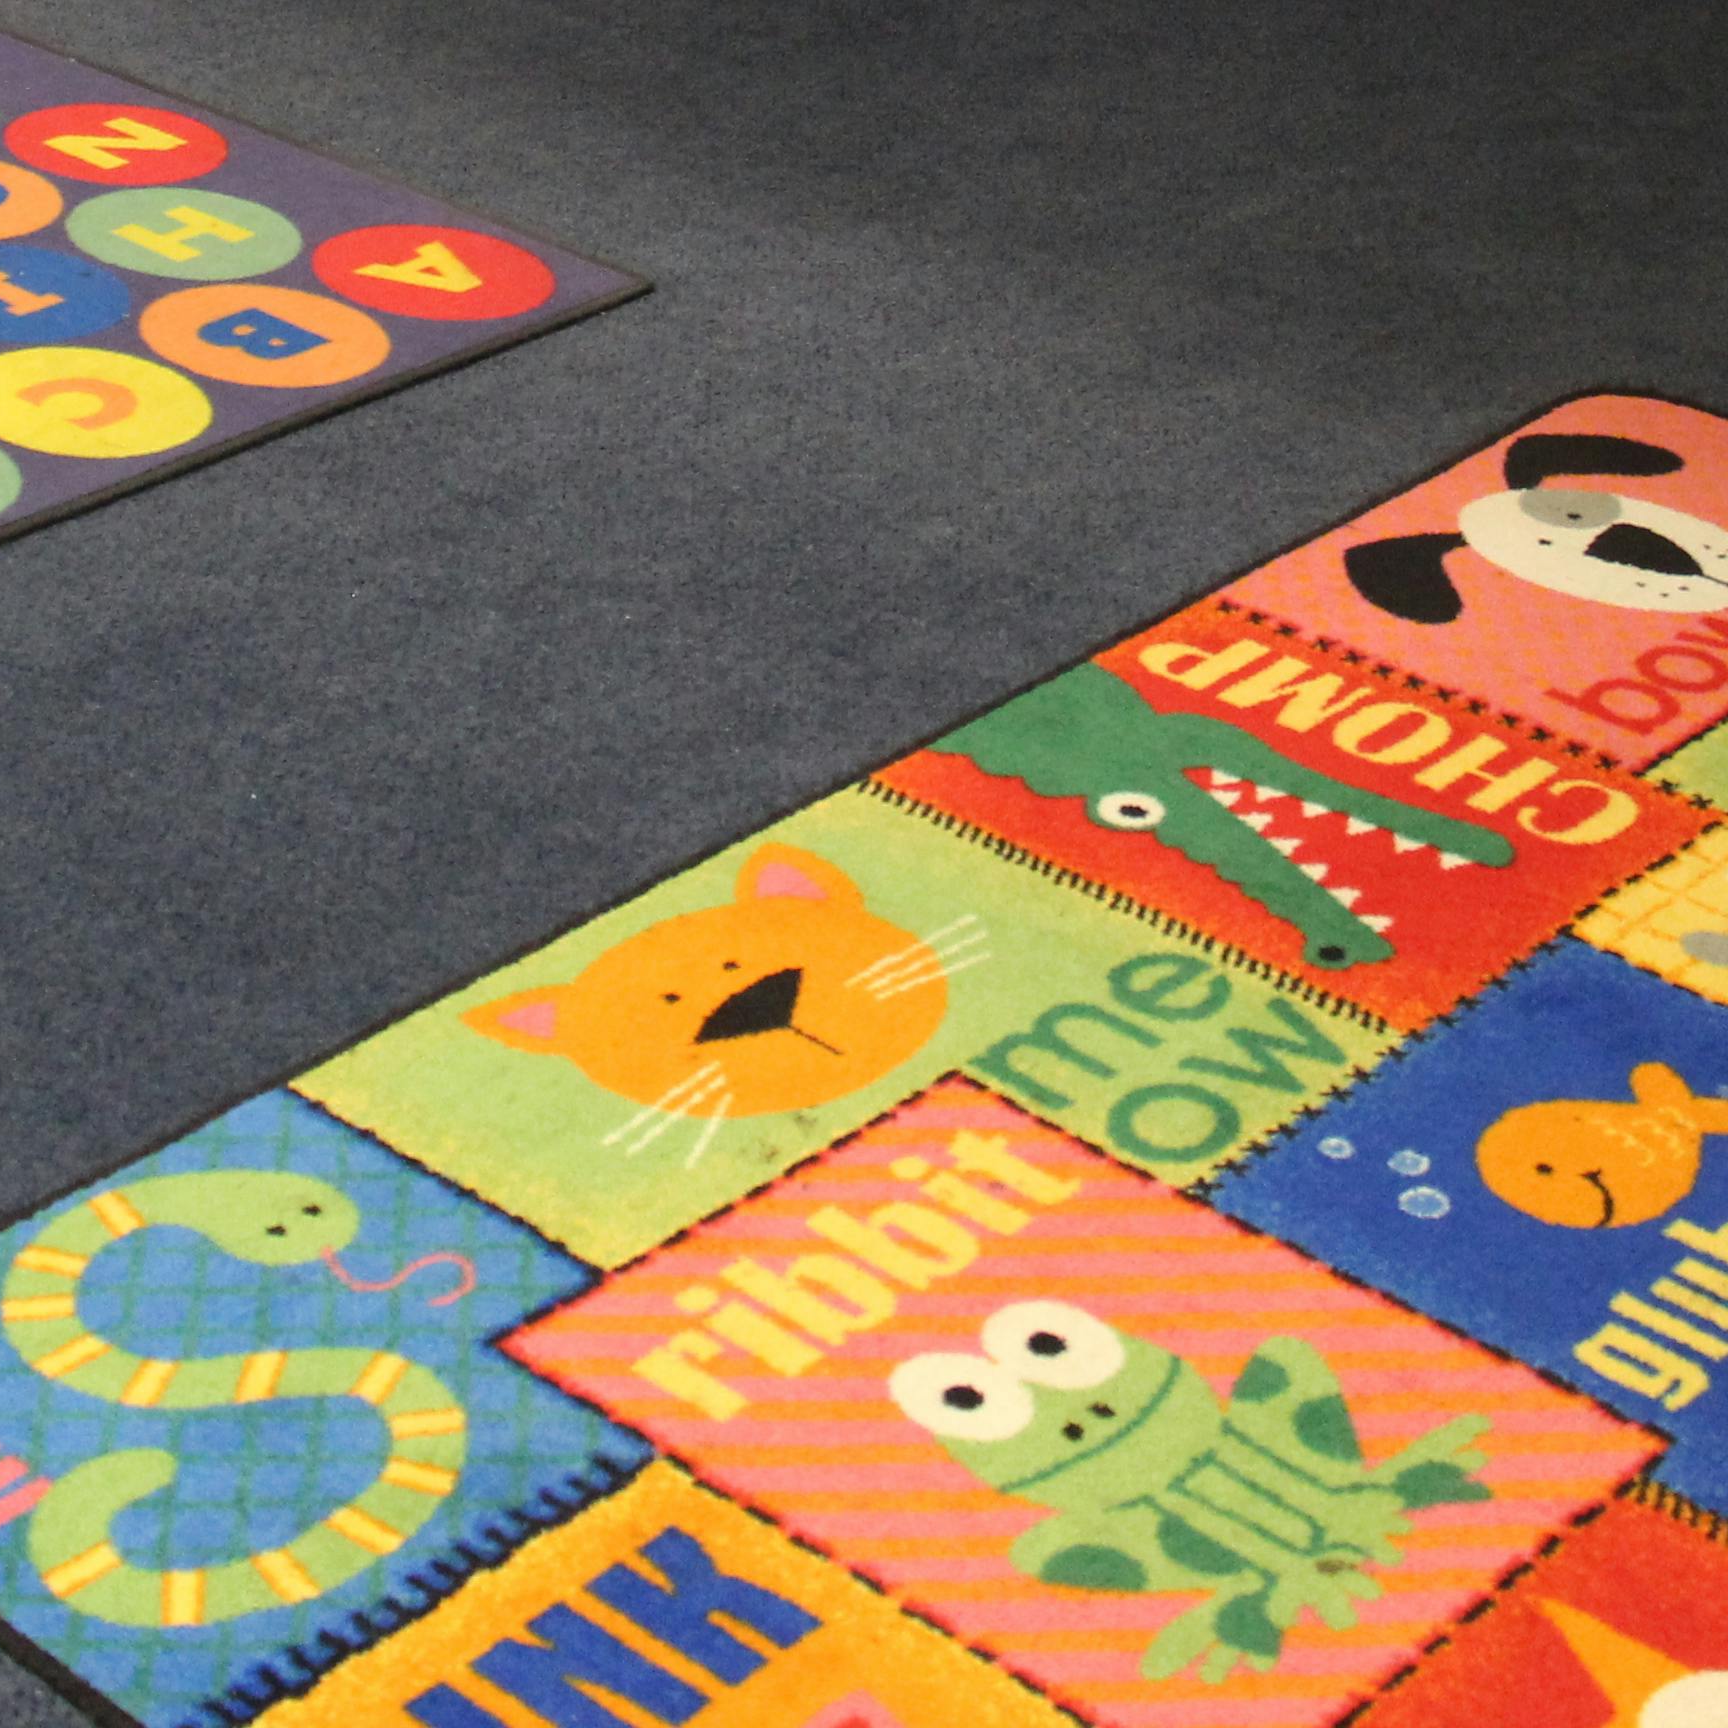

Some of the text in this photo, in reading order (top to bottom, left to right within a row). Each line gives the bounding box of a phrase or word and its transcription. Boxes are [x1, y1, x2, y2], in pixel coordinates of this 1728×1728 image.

[46, 118, 185, 169] N
[115, 206, 253, 261] H
[356, 242, 481, 292] A
[198, 308, 328, 360] B
[18, 377, 138, 430] C
[1138, 638, 1640, 847] CHOMP
[967, 952, 1233, 1111] me
[1106, 997, 1350, 1164] ow
[631, 1130, 1084, 1423] ribbit
